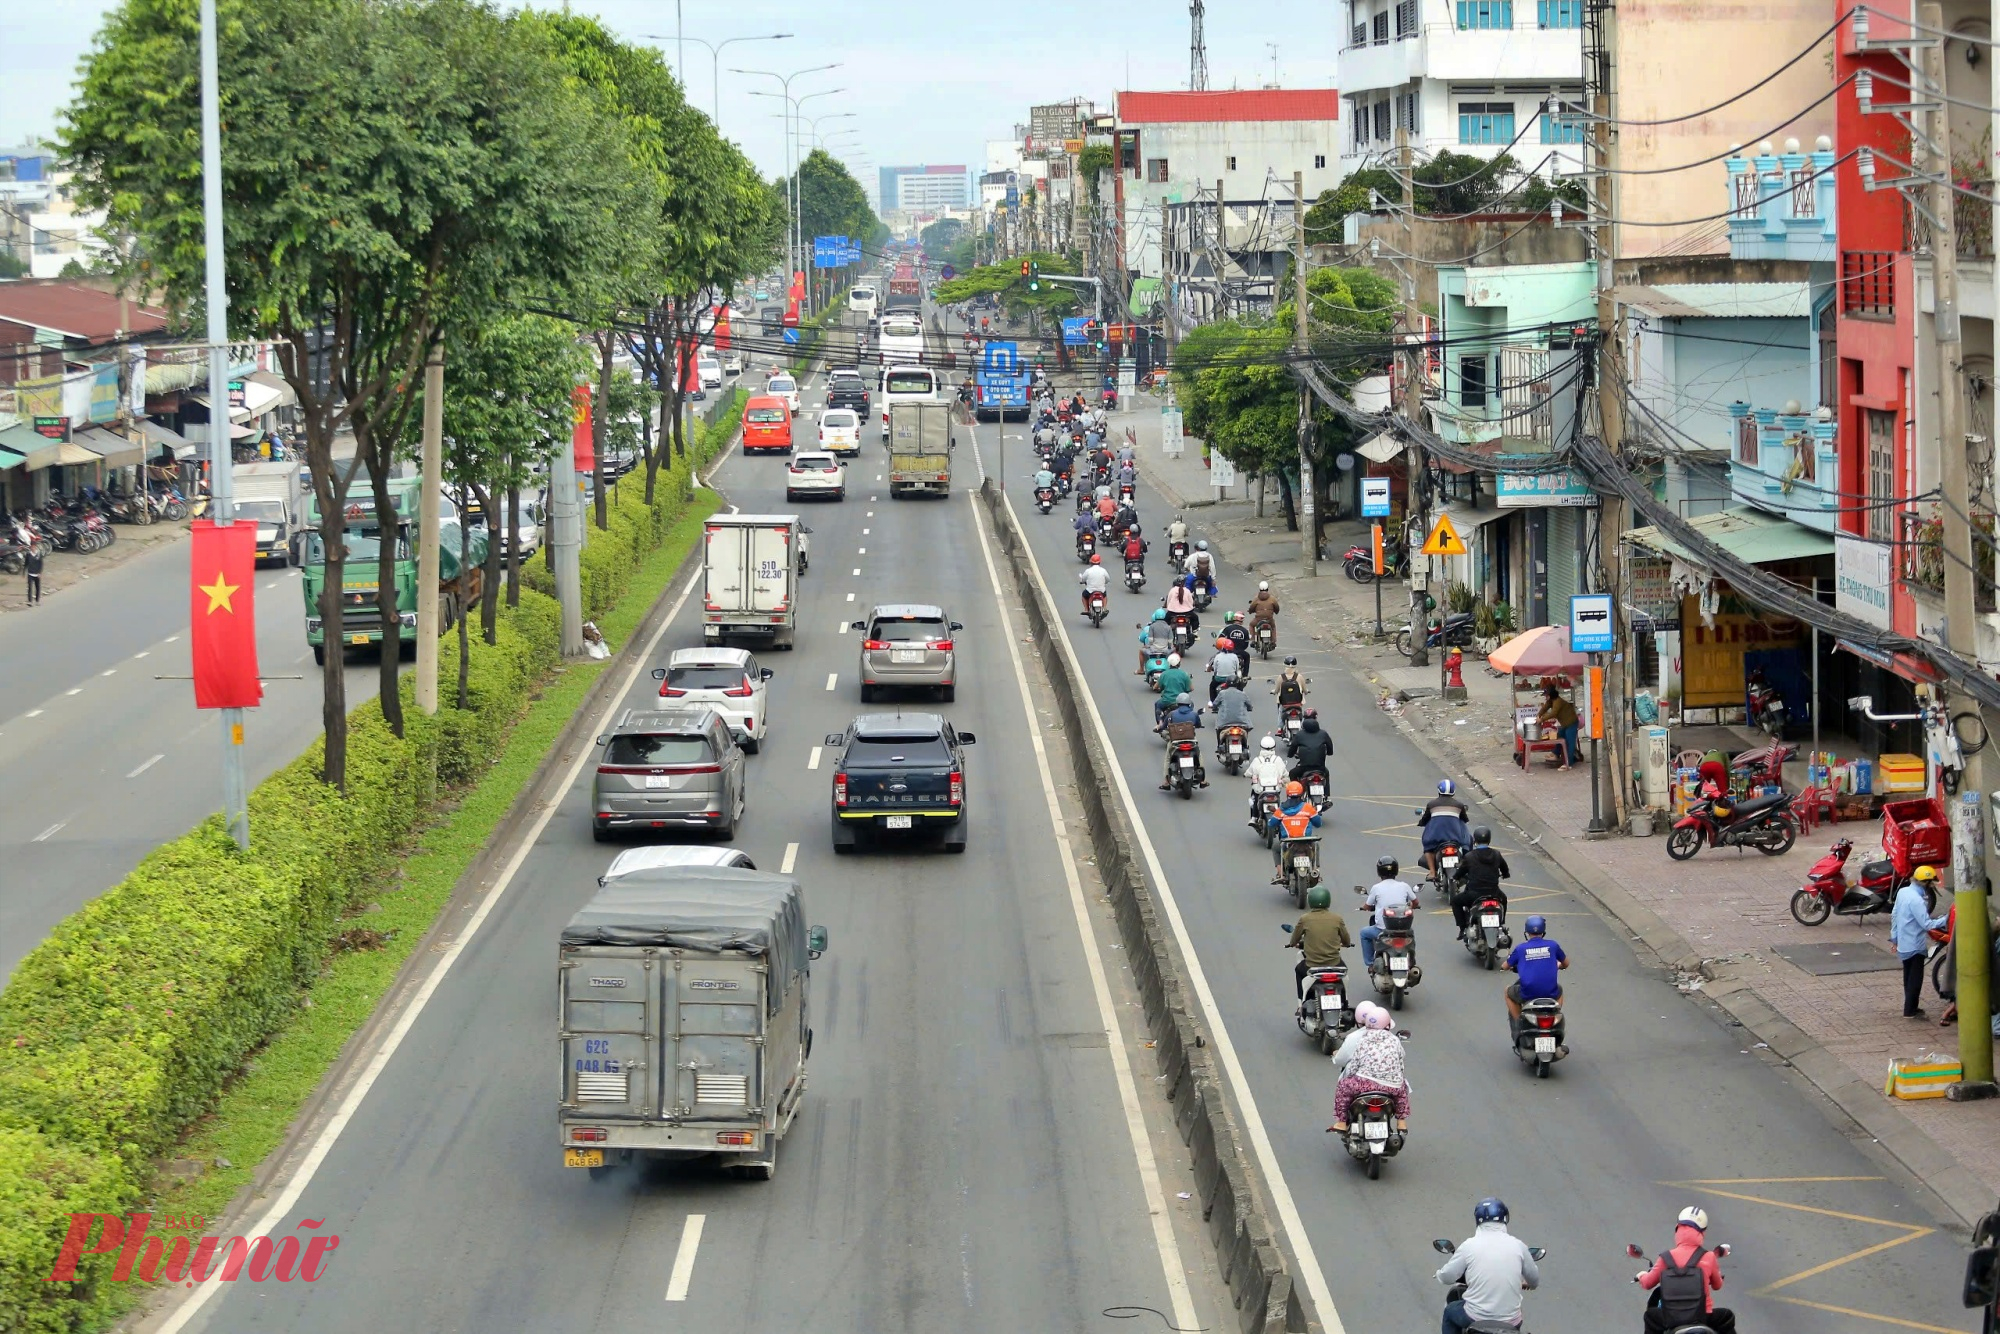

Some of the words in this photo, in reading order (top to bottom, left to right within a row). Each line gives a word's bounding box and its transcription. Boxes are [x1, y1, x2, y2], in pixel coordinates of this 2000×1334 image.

[762, 561, 776, 570] 51D
[757, 570, 781, 579] 122.30
[850, 795, 948, 803] RANGER
[592, 978, 624, 987] THACO
[692, 981, 738, 989] FRONTIER
[586, 1040, 609, 1054] 62C
